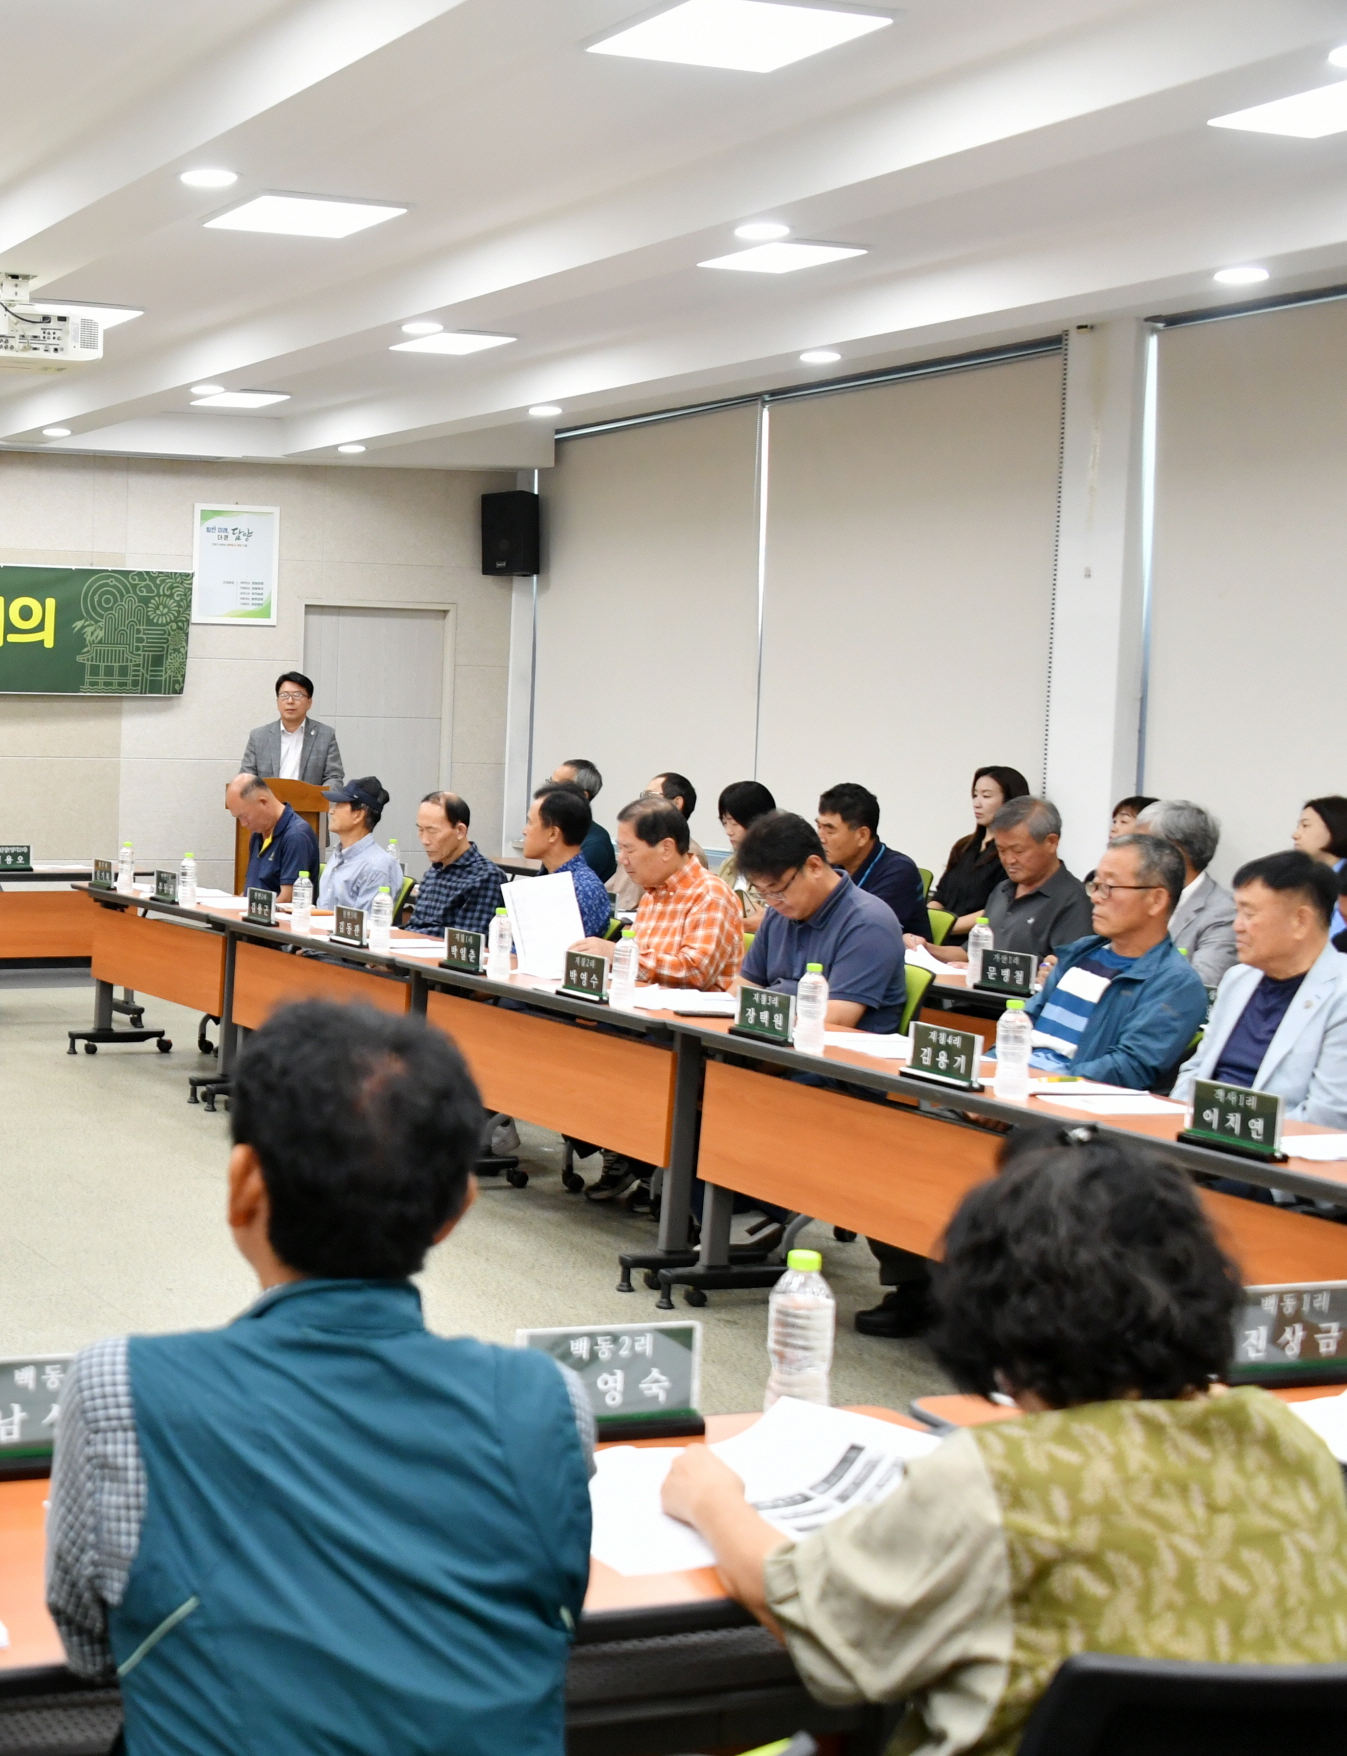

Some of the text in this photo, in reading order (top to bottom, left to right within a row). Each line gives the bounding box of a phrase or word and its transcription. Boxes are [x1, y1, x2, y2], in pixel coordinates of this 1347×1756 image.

[569, 969, 599, 989] 박영수
[745, 1007, 784, 1031] 장택원
[919, 1047, 967, 1075] 김용기
[1202, 1107, 1265, 1141] 이치연
[1260, 1290, 1331, 1317] 백동1리
[569, 1332, 654, 1361] 백동2리
[1241, 1322, 1345, 1361] 진상금
[13, 1364, 65, 1392] 백동
[596, 1367, 672, 1408] 영숙
